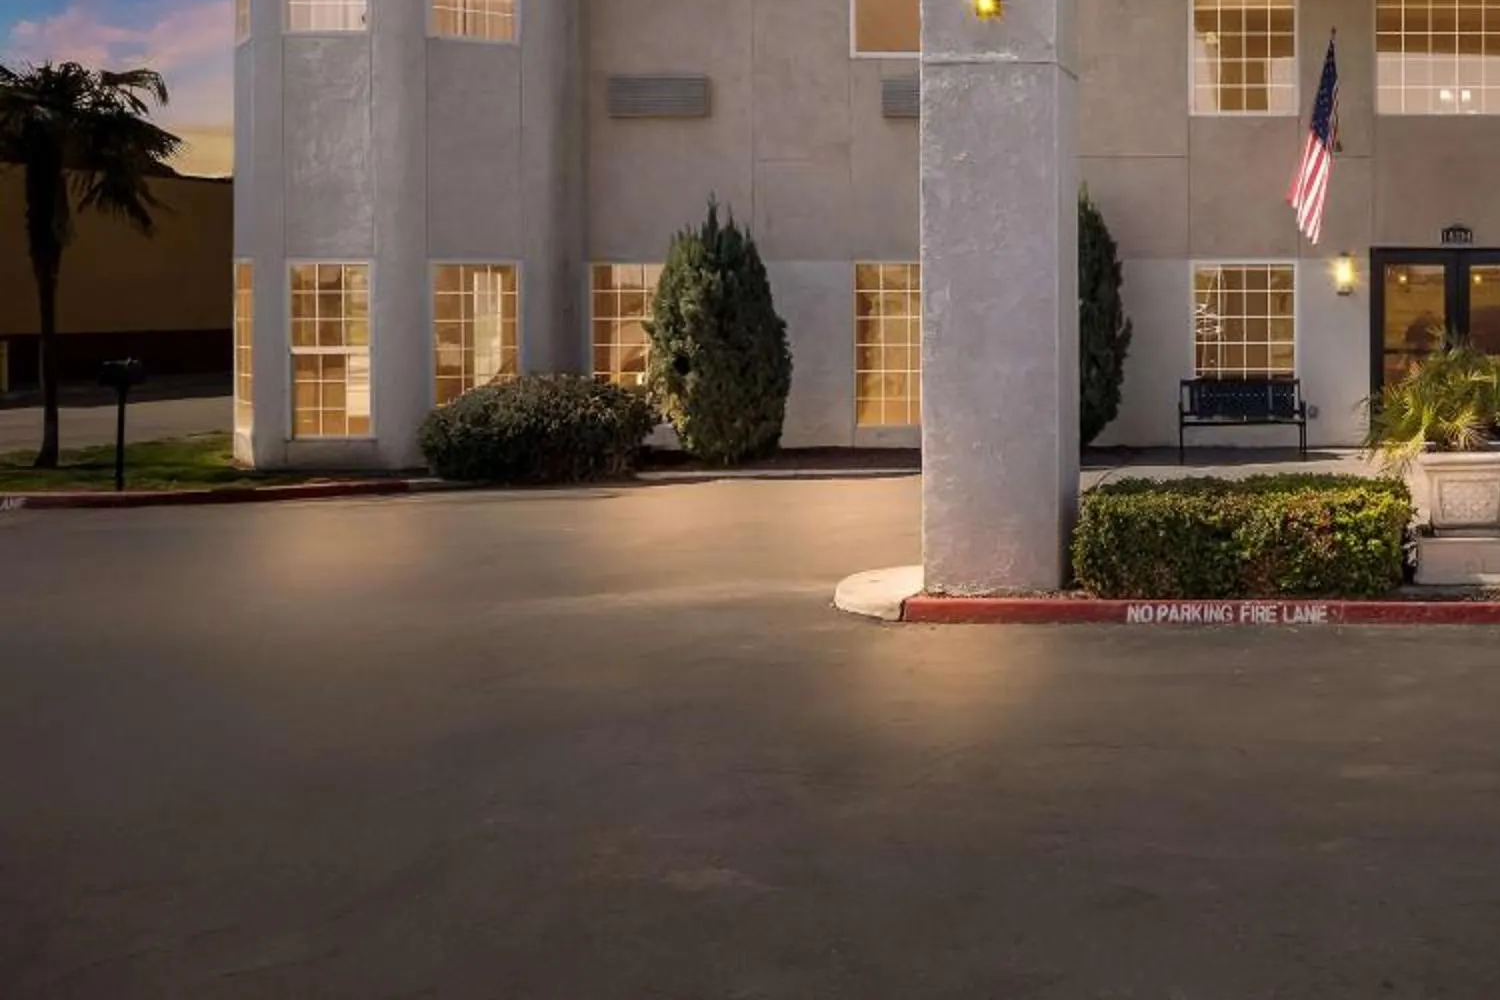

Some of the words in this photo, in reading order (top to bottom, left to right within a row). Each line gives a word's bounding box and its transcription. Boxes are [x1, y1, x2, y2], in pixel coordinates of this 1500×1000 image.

[1127, 603, 1153, 623] NO
[1156, 603, 1234, 623] PARKING
[1239, 602, 1277, 624] FIRE
[1283, 603, 1328, 623] LANE
